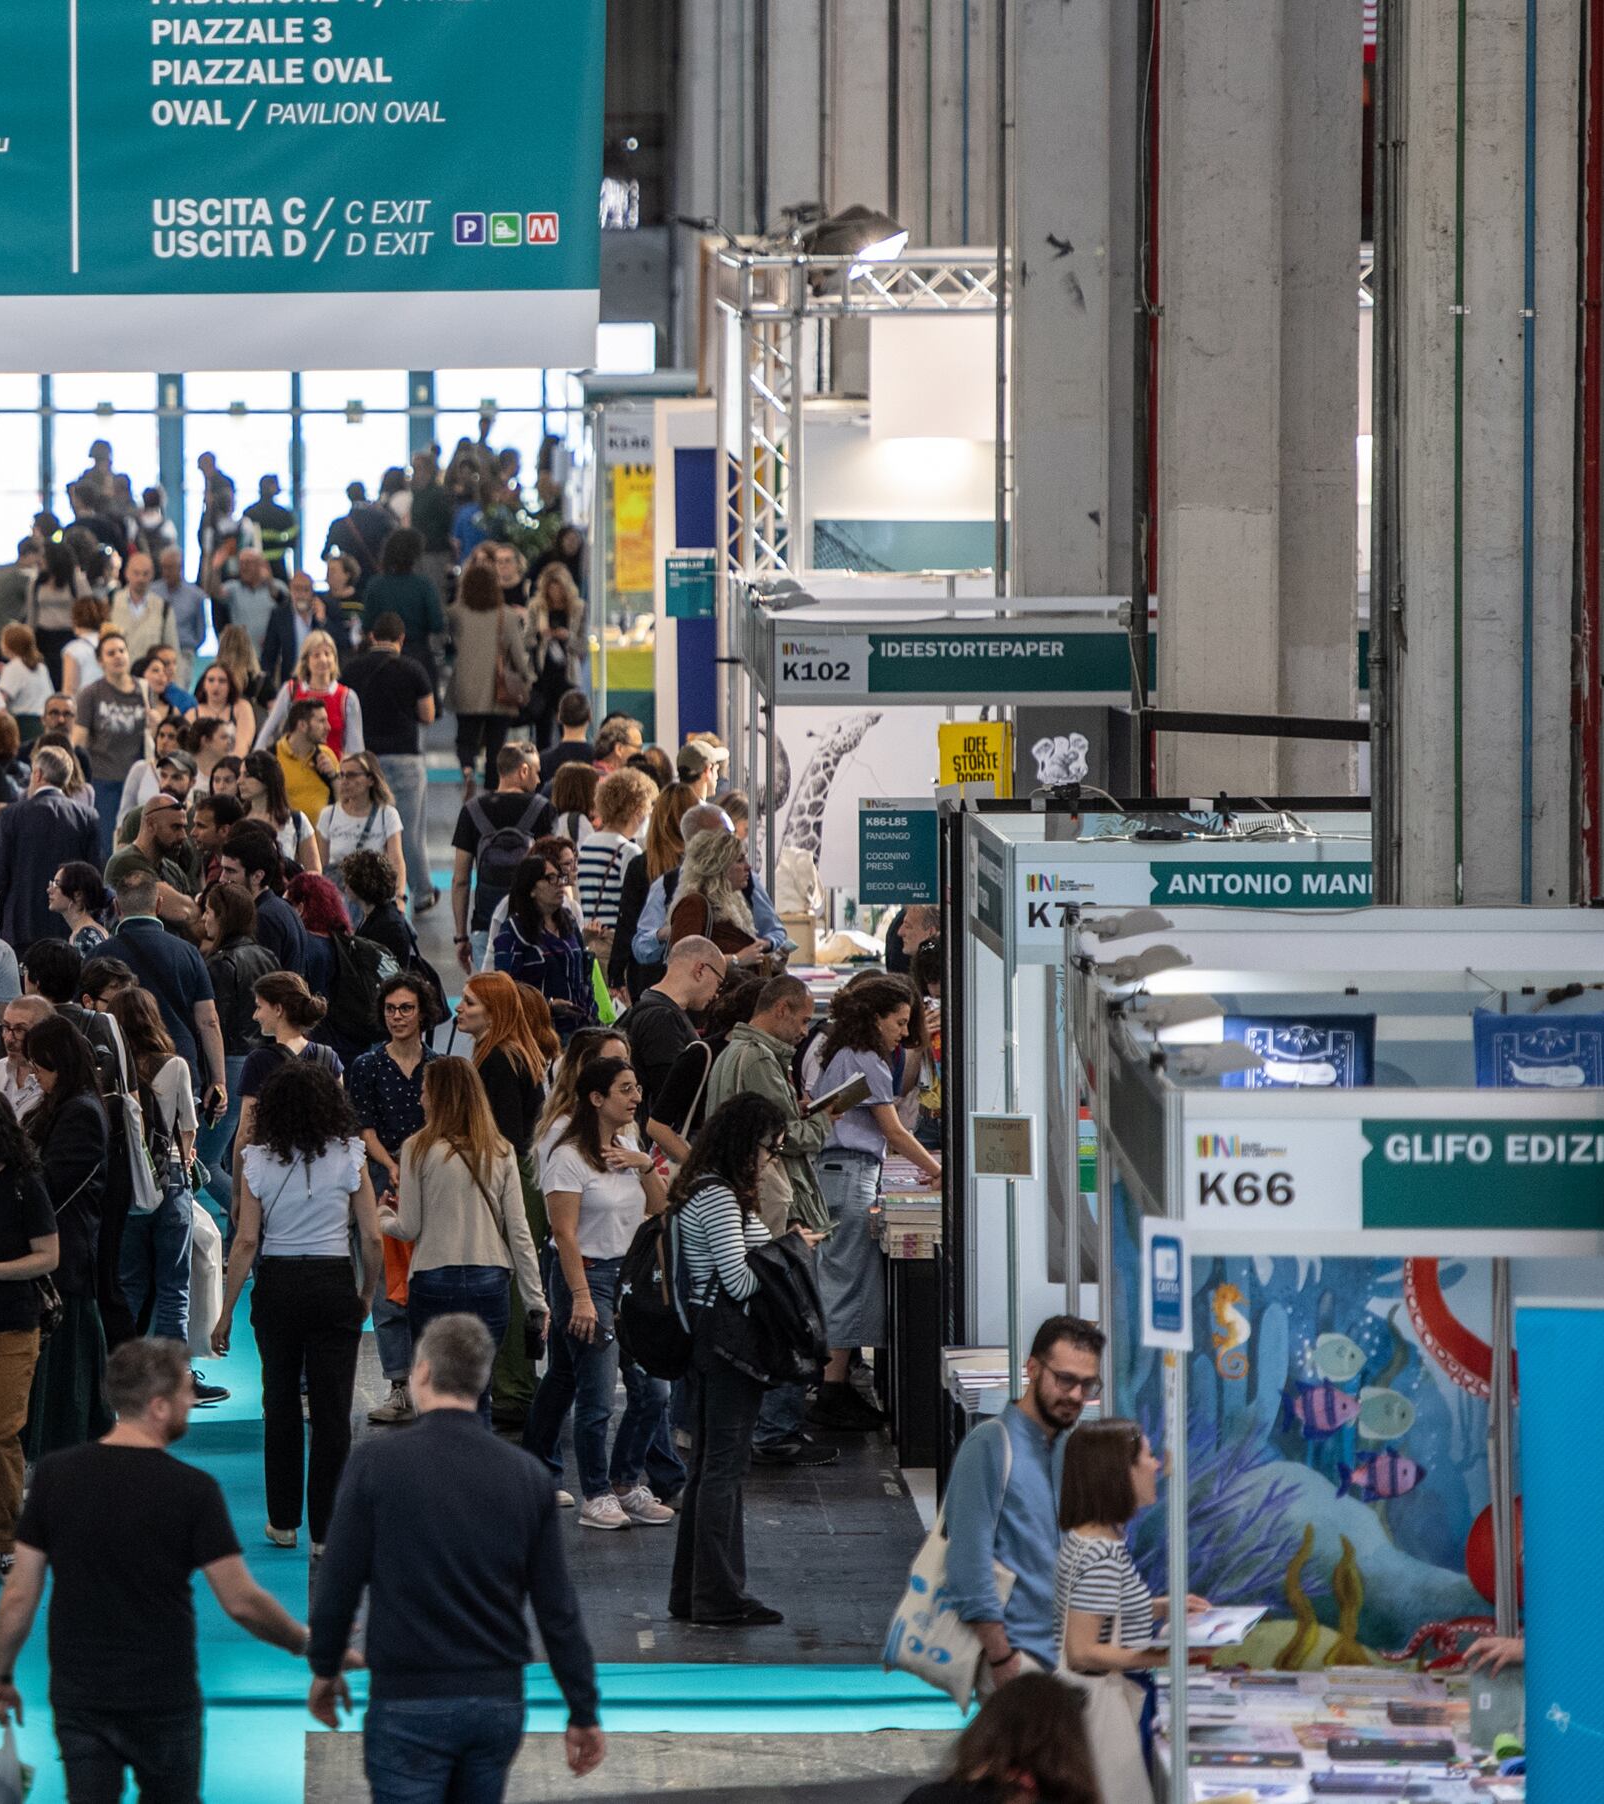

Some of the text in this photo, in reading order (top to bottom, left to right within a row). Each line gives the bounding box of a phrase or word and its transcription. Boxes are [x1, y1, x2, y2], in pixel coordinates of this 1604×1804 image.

[152, 17, 332, 45] PIAZZALE 3
[152, 57, 392, 85] PIAZZALE OVAL
[151, 100, 231, 127] OVAL
[266, 102, 378, 125] PAVILION
[384, 101, 447, 123] OVAL
[153, 199, 274, 227] USCITA
[282, 198, 307, 225] C
[345, 200, 364, 224] C
[371, 200, 432, 224] EXIT
[153, 229, 274, 258] USCITA
[282, 229, 307, 257] D
[346, 232, 366, 256] D
[374, 232, 434, 256] EXIT
[880, 641, 1065, 657] IDEESTORTEPAPER
[782, 661, 851, 682] K102
[963, 736, 989, 753] IDEE
[953, 751, 999, 773] STORTE
[865, 817, 908, 826] K86-L85
[866, 832, 911, 840] FANDANGO
[866, 852, 911, 860] COCONINO
[866, 862, 894, 870] PRESS
[866, 882, 926, 890] BECCO GIALLO
[1167, 873, 1292, 895] ANTONIO
[1384, 1133, 1493, 1164] GLIFO
[1198, 1171, 1295, 1207] K66
